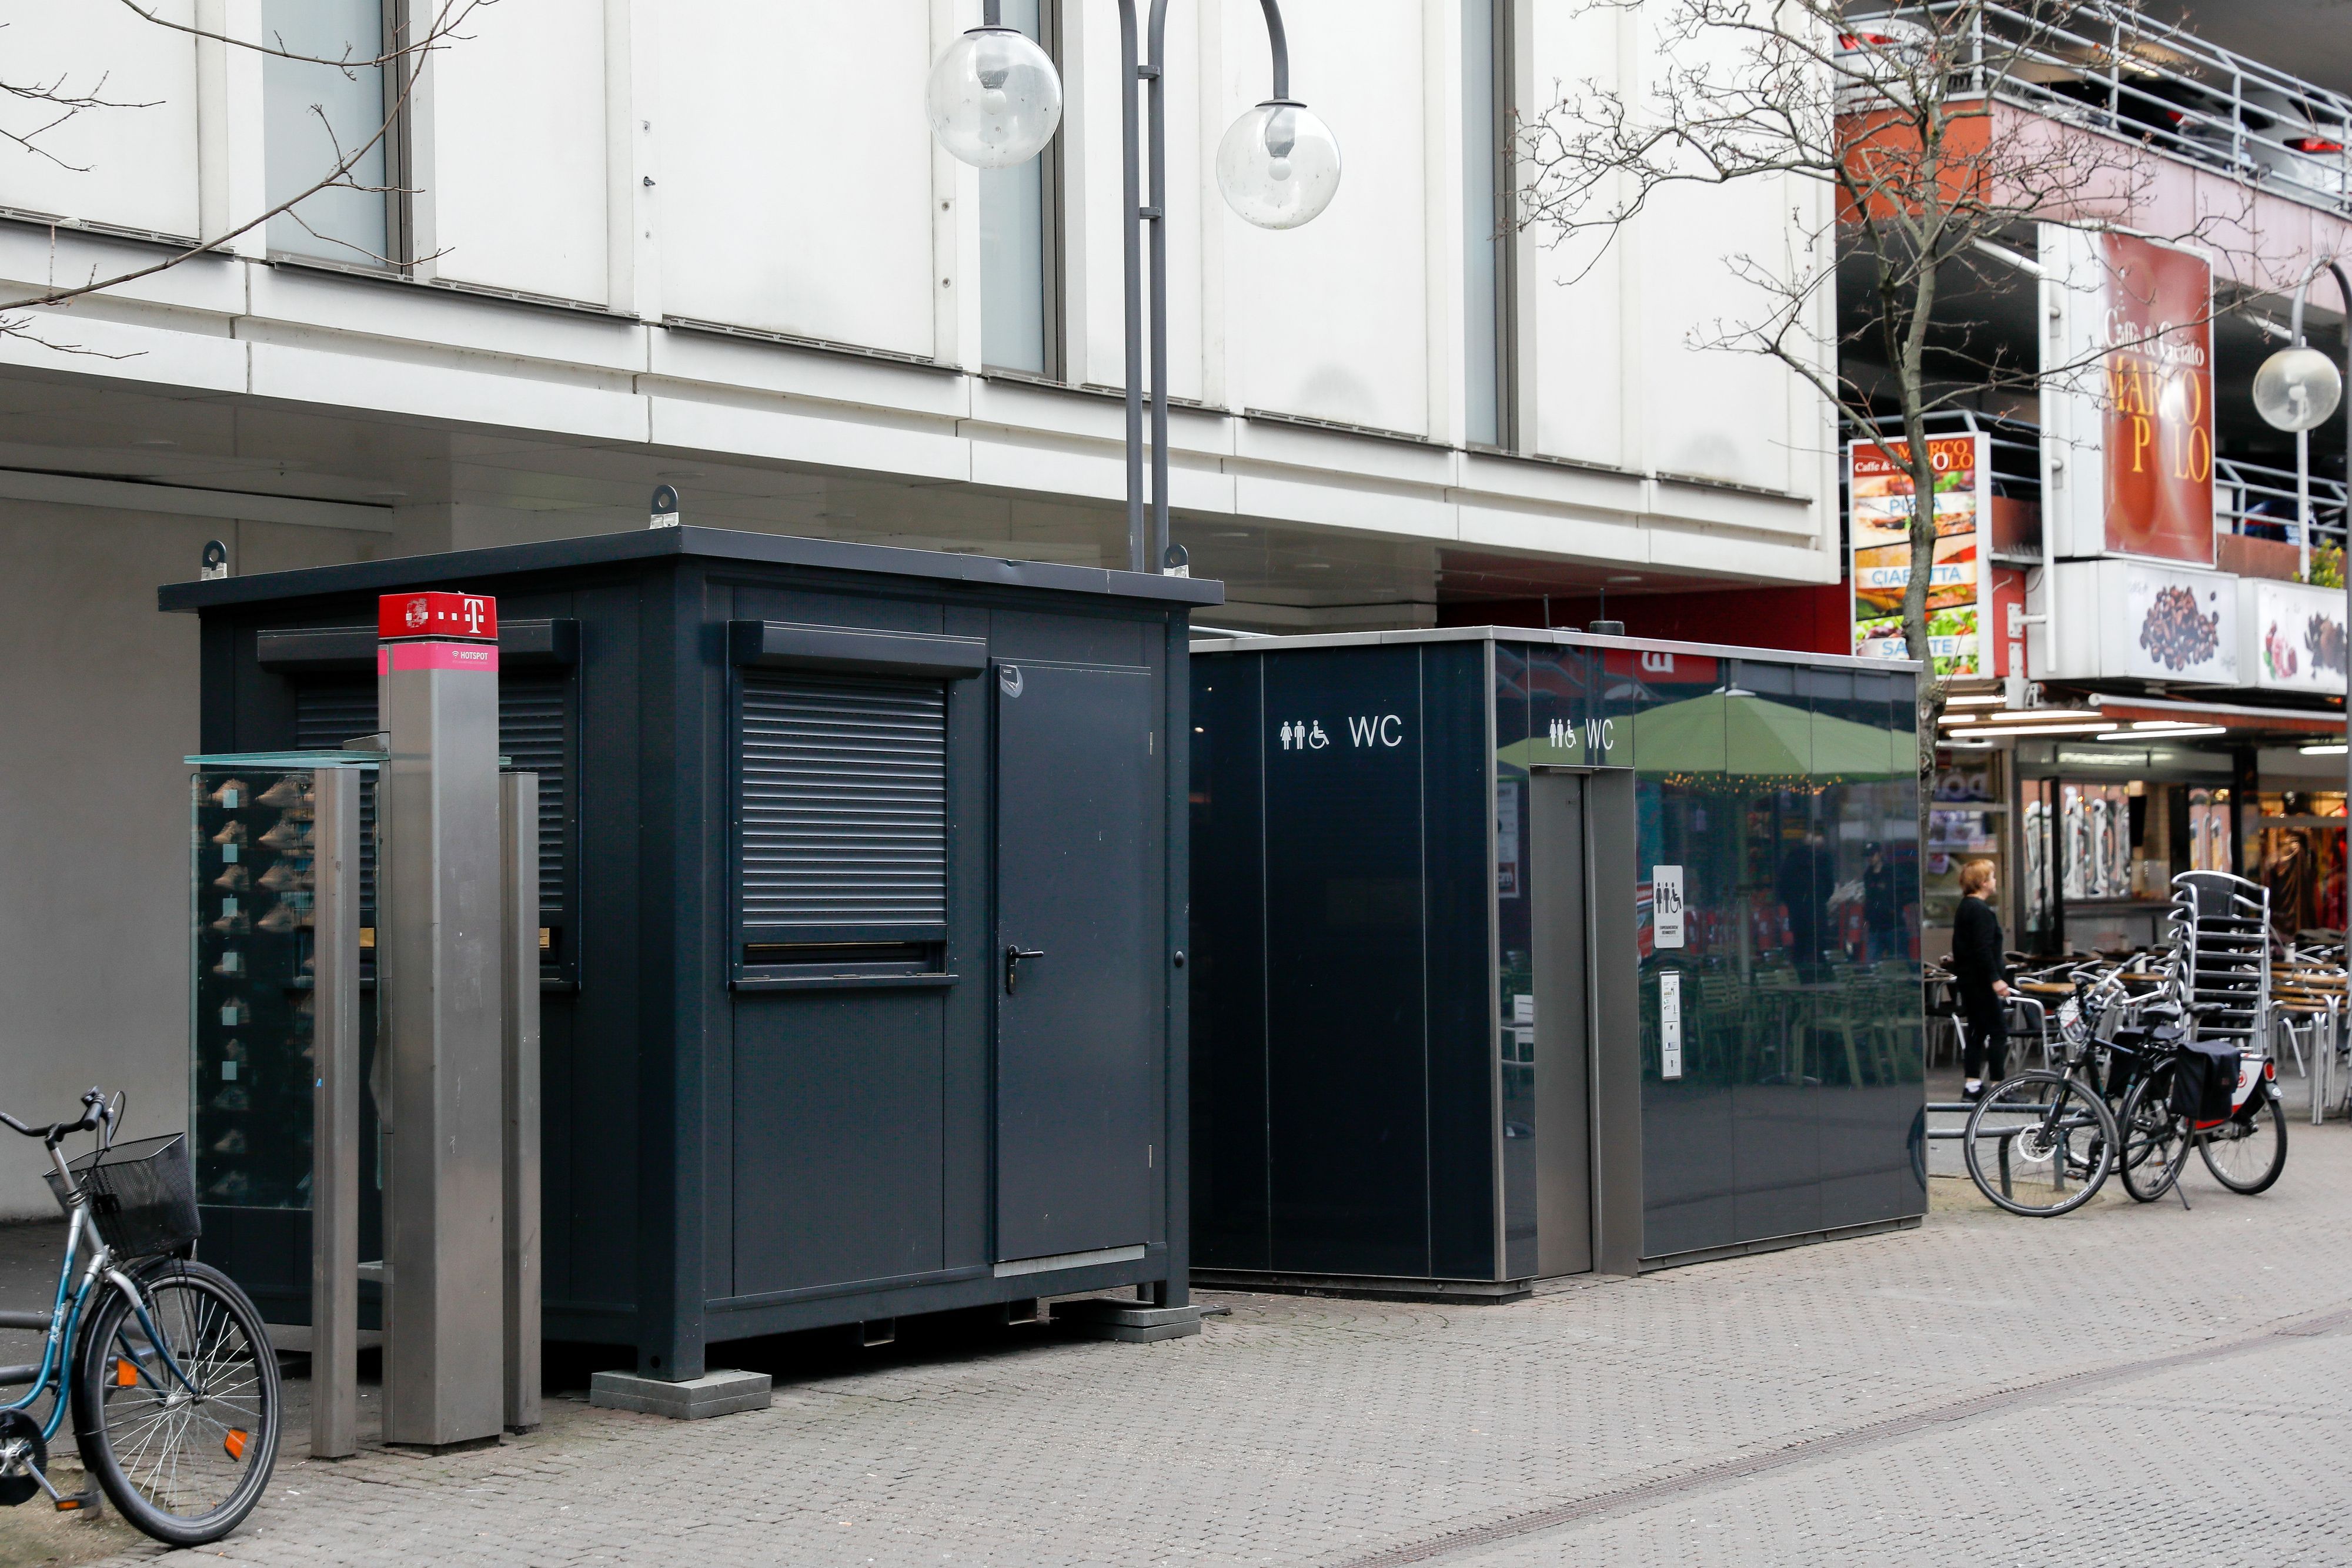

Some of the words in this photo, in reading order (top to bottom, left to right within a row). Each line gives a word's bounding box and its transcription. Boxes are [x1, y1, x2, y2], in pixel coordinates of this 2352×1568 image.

[1898, 440, 1969, 459] MRCO
[464, 598, 484, 634] T
[460, 651, 488, 660] HOTSPOT
[1882, 638, 1953, 656] SATE
[1348, 714, 1402, 747] WC
[1585, 718, 1613, 750] WC
